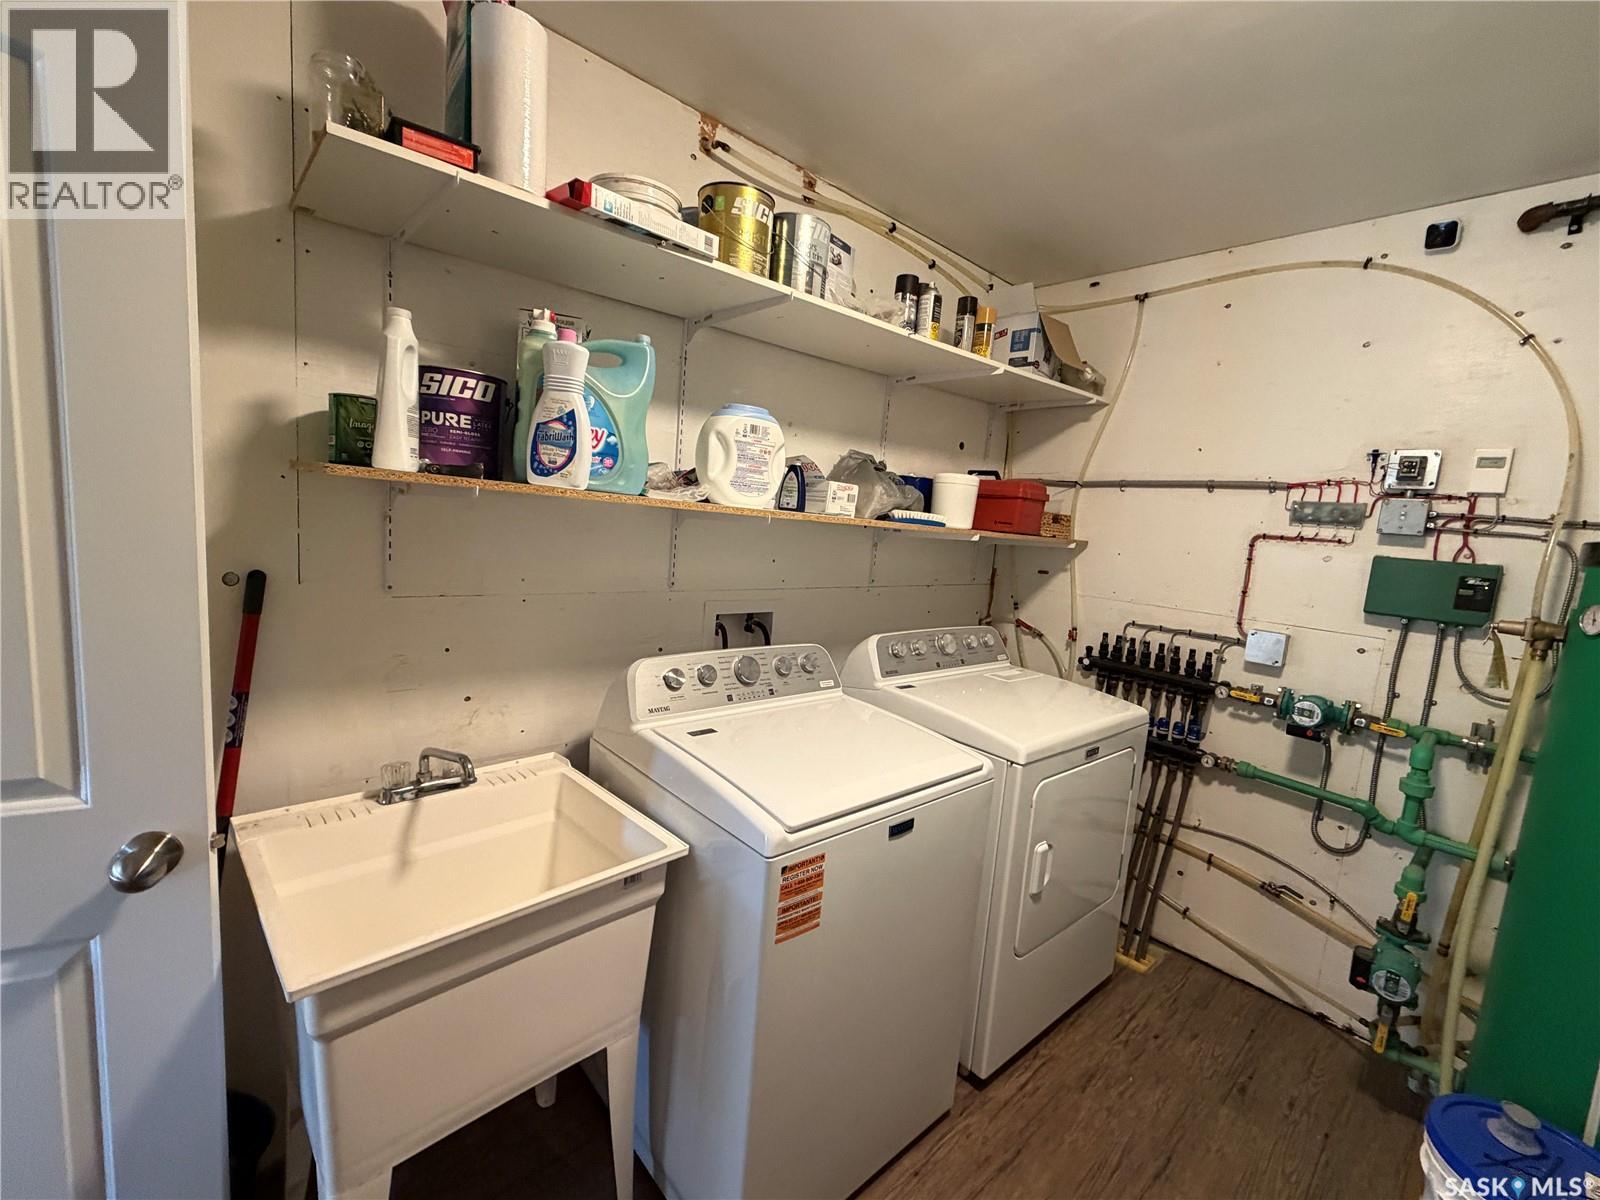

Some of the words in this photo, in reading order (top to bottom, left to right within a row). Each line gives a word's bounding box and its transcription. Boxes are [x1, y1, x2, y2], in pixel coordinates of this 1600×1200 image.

[420, 372, 496, 403] SICO
[421, 410, 472, 430] PURE
[782, 869, 810, 883] REGISTER
[810, 863, 824, 875] NOW
